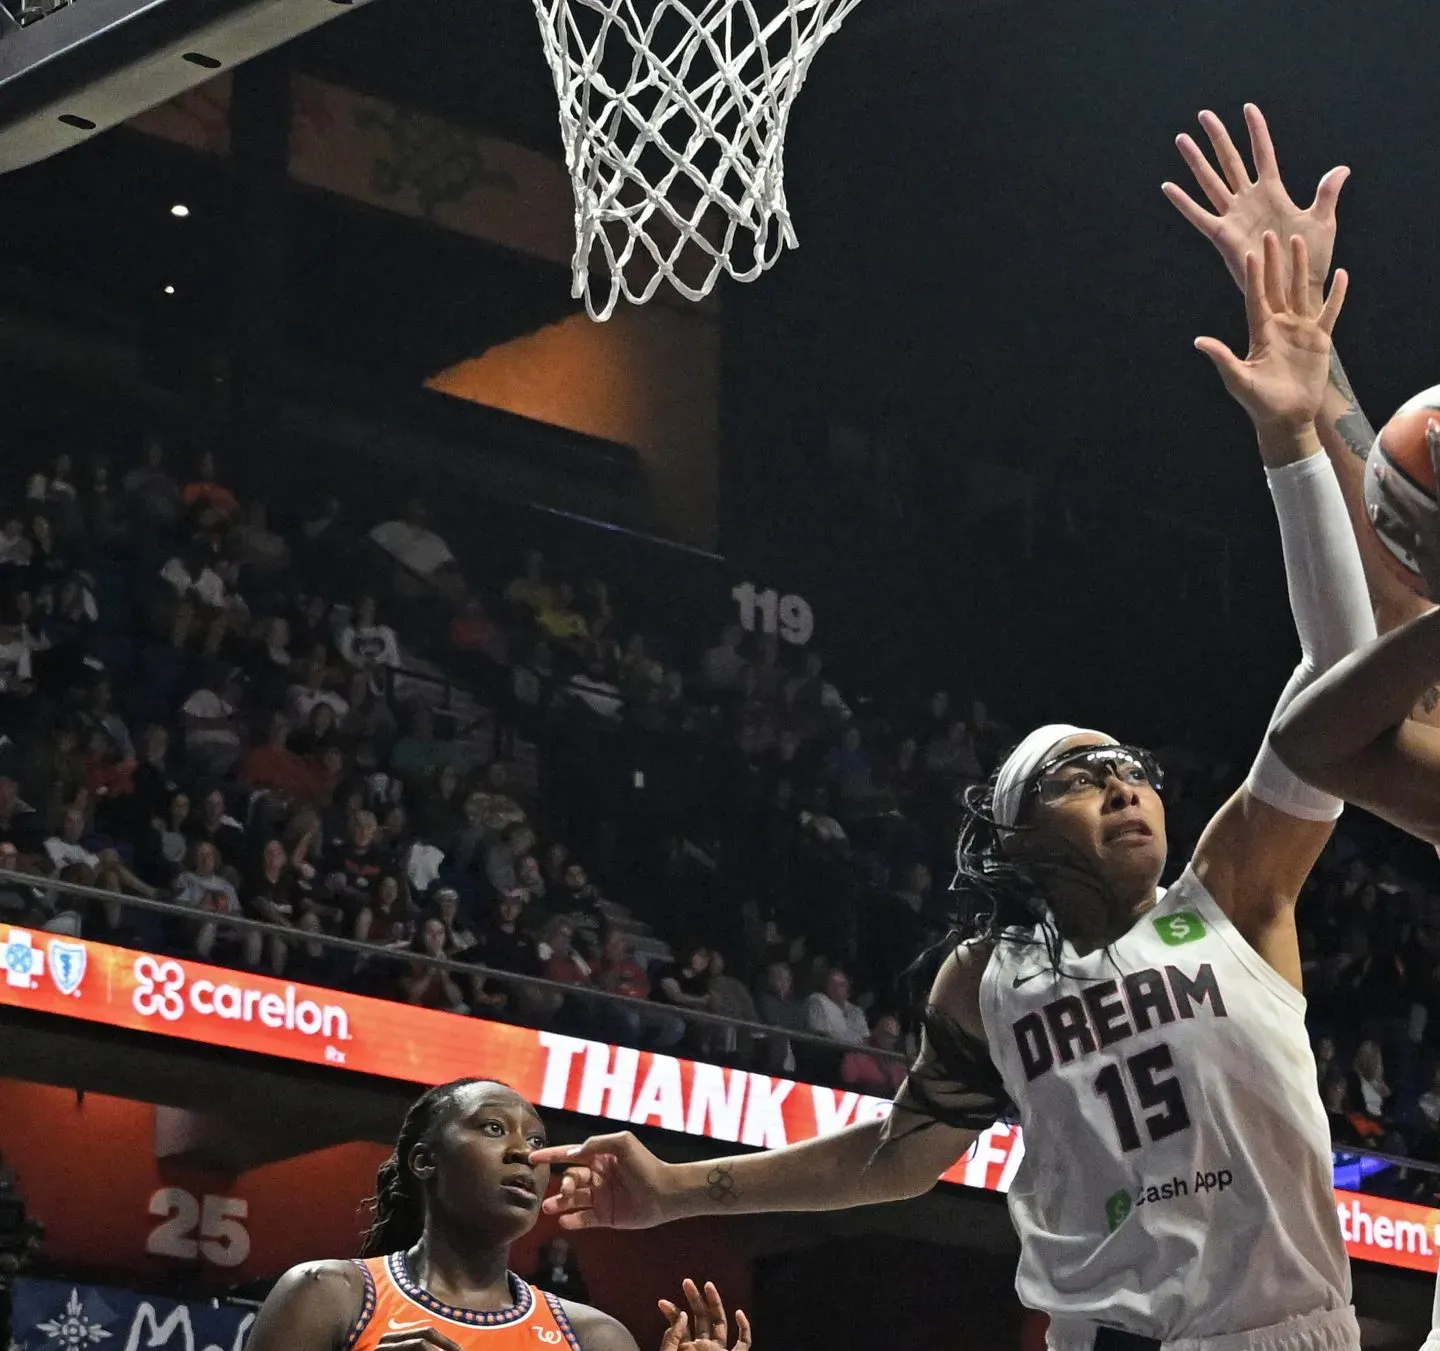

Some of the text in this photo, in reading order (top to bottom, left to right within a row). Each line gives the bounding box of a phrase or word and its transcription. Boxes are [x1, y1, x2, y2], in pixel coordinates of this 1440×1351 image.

[731, 582, 814, 645] 119
[190, 980, 348, 1039] carelon
[1012, 963, 1228, 1082] DREAM
[324, 1045, 346, 1064] Rx
[538, 1030, 794, 1150] THANK
[1093, 1043, 1192, 1153] 15
[1195, 1169, 1233, 1195] App
[147, 1187, 250, 1267] 25
